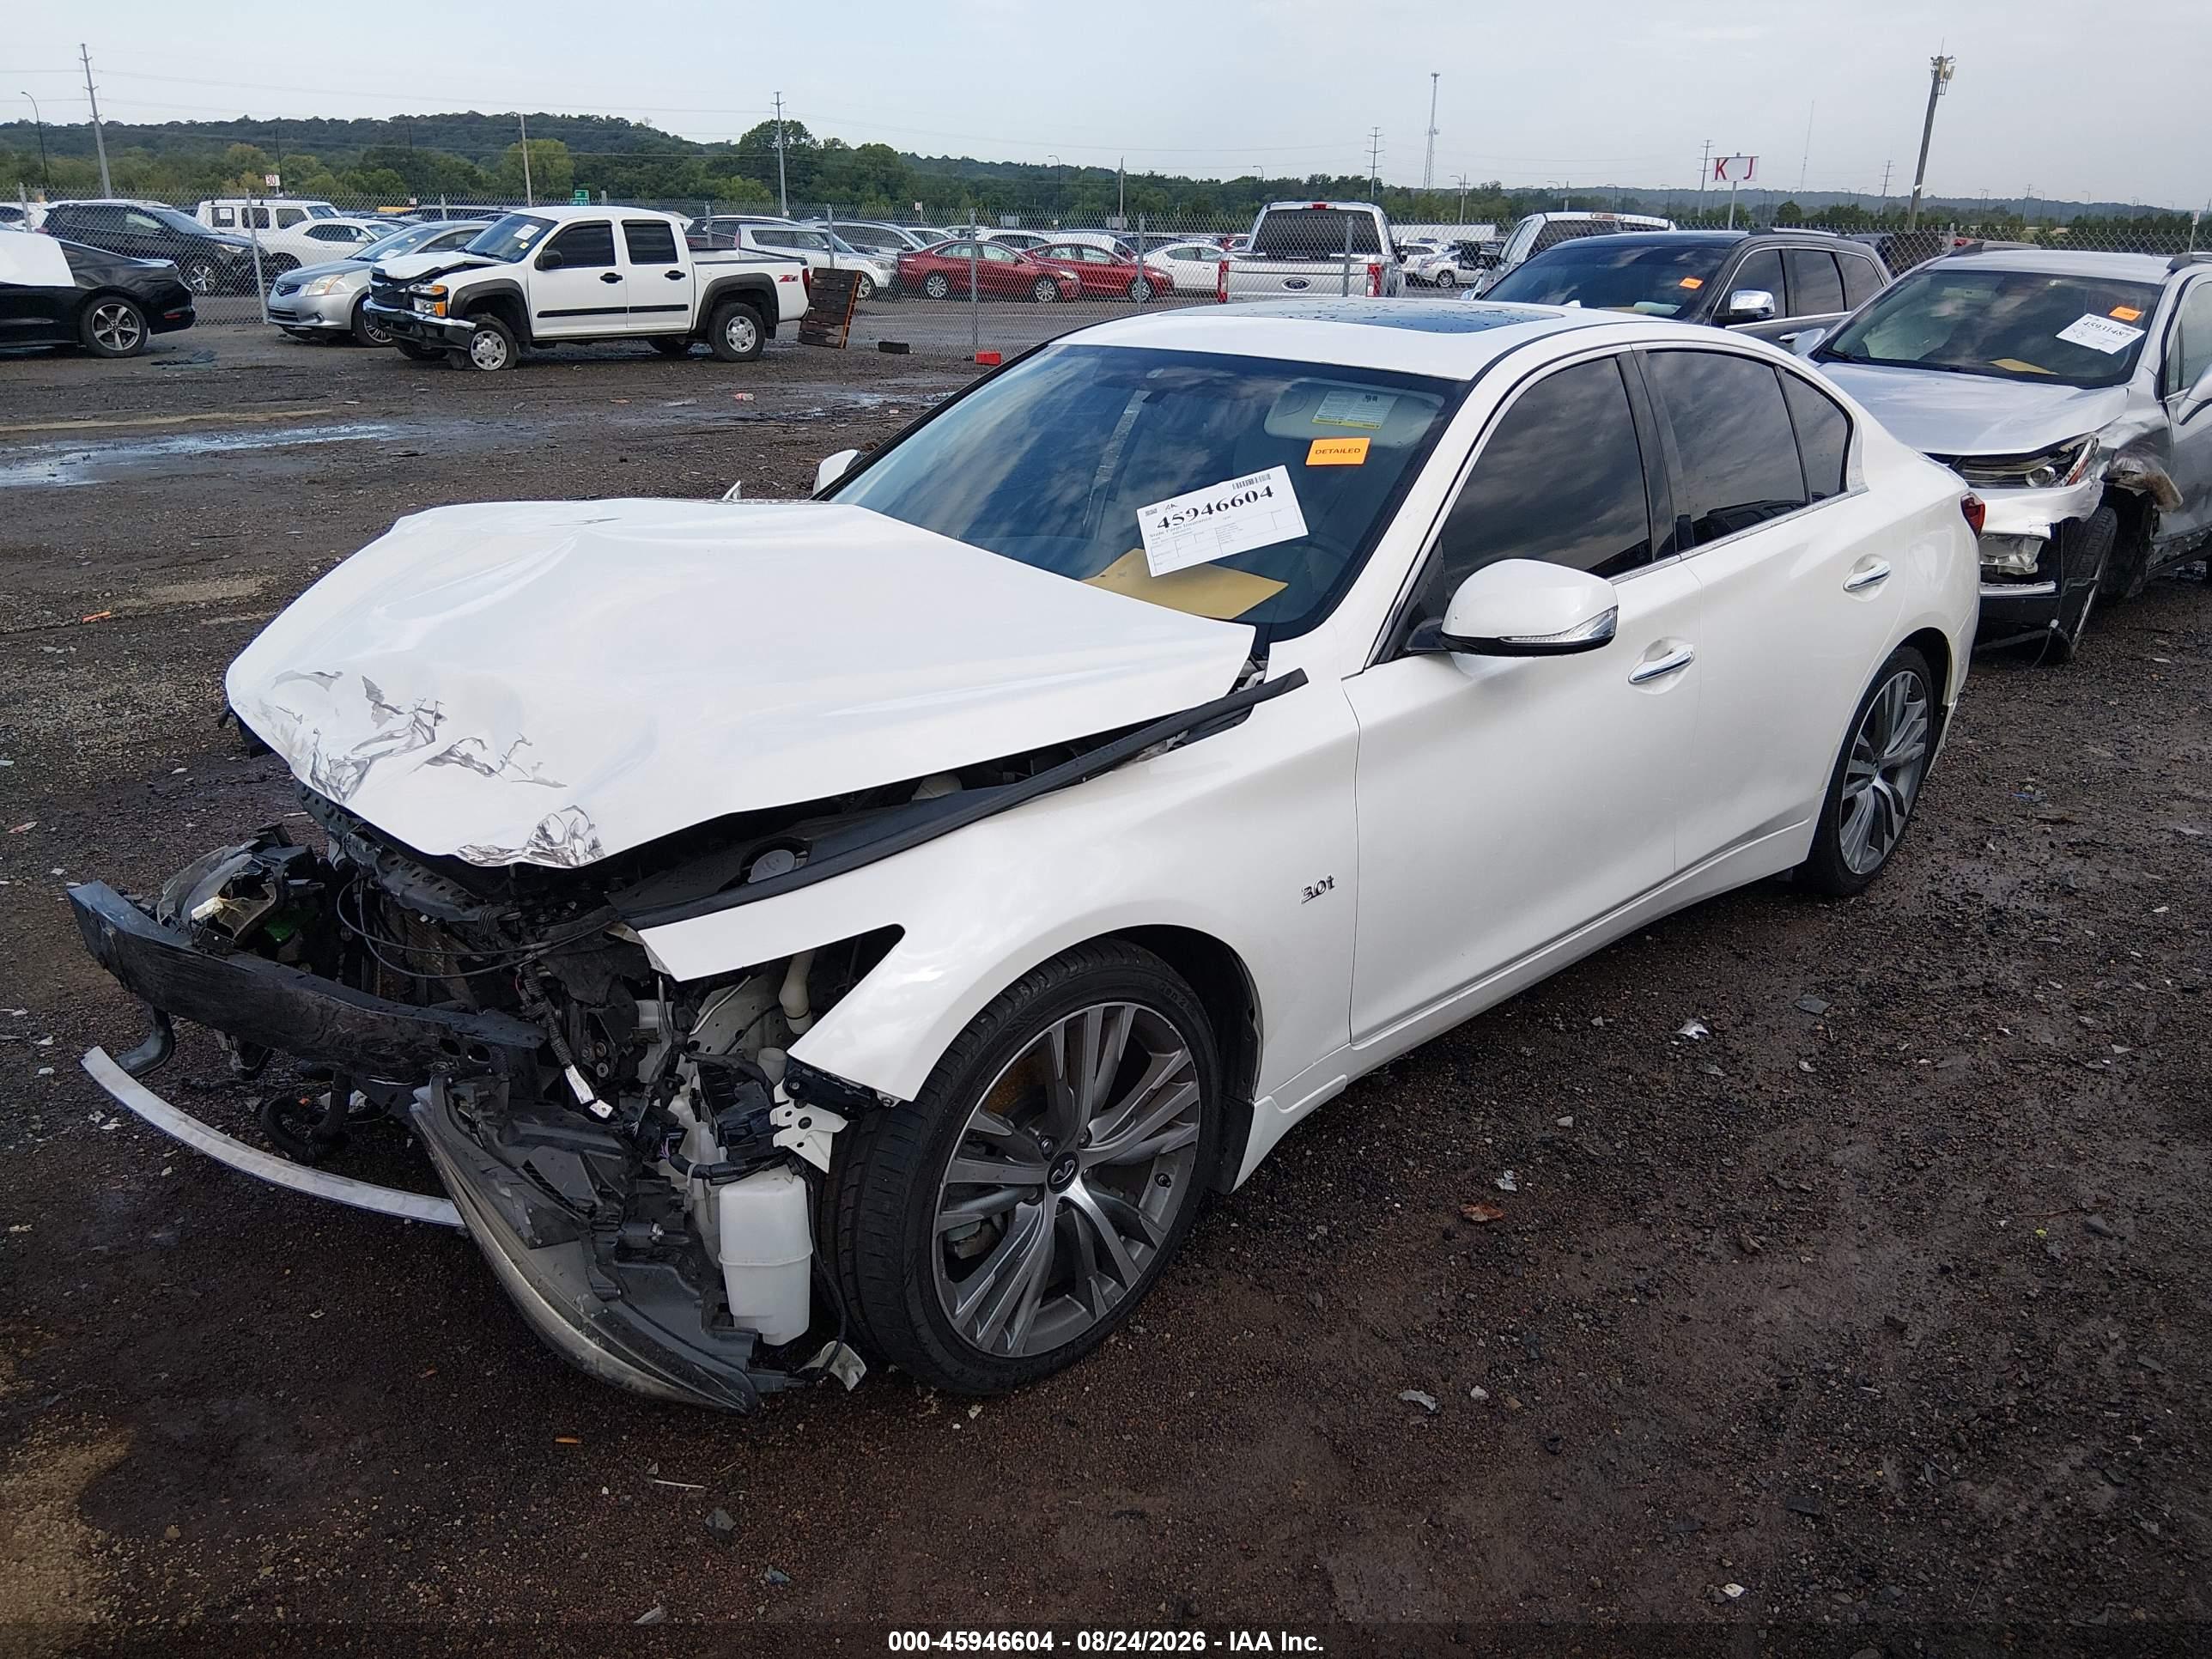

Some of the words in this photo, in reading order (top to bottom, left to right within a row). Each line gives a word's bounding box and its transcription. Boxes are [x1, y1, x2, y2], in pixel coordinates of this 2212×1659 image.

[1715, 158, 1729, 180] K
[1743, 158, 1753, 180] J
[1157, 485, 1274, 529] 45946604
